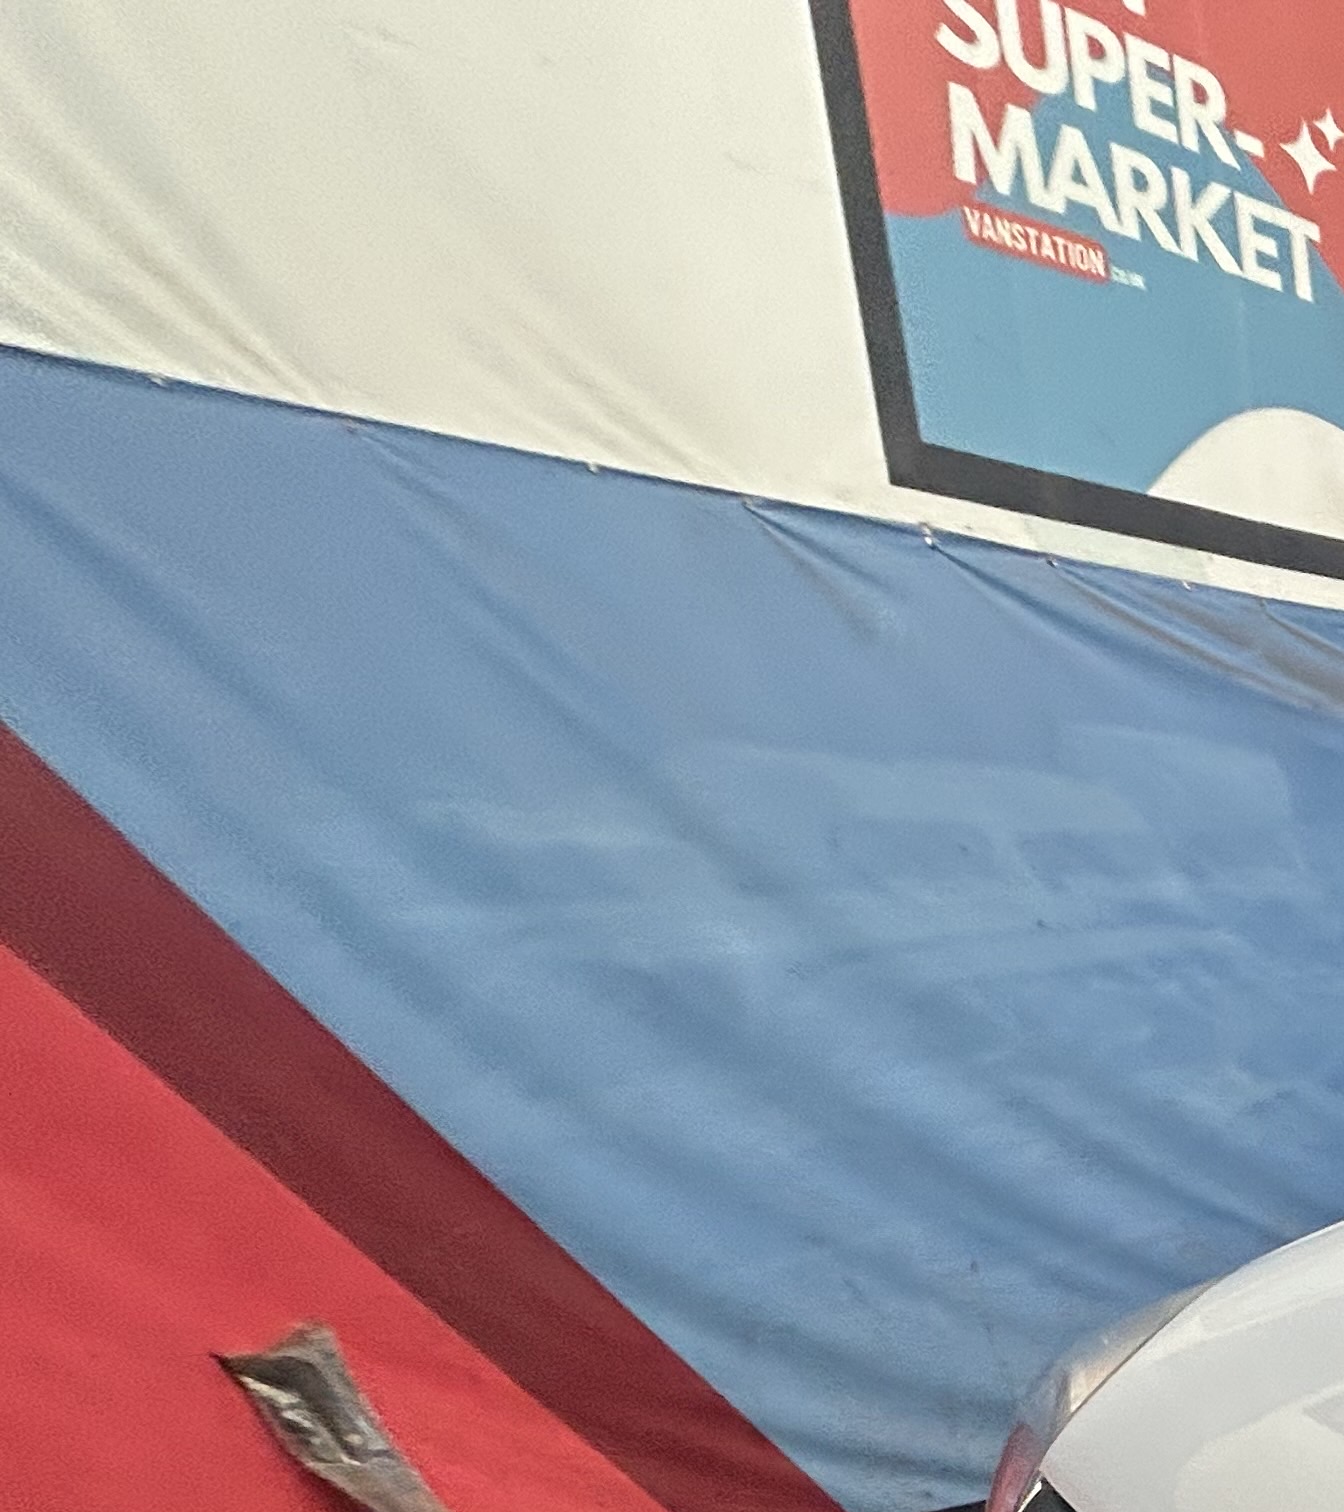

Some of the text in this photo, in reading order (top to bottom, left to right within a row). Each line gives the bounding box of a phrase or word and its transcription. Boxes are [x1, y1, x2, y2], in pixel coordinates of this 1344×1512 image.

[934, 0, 1265, 172] SUPER-
[947, 81, 1321, 303] MARKET
[962, 205, 1106, 278] VANSTATION
